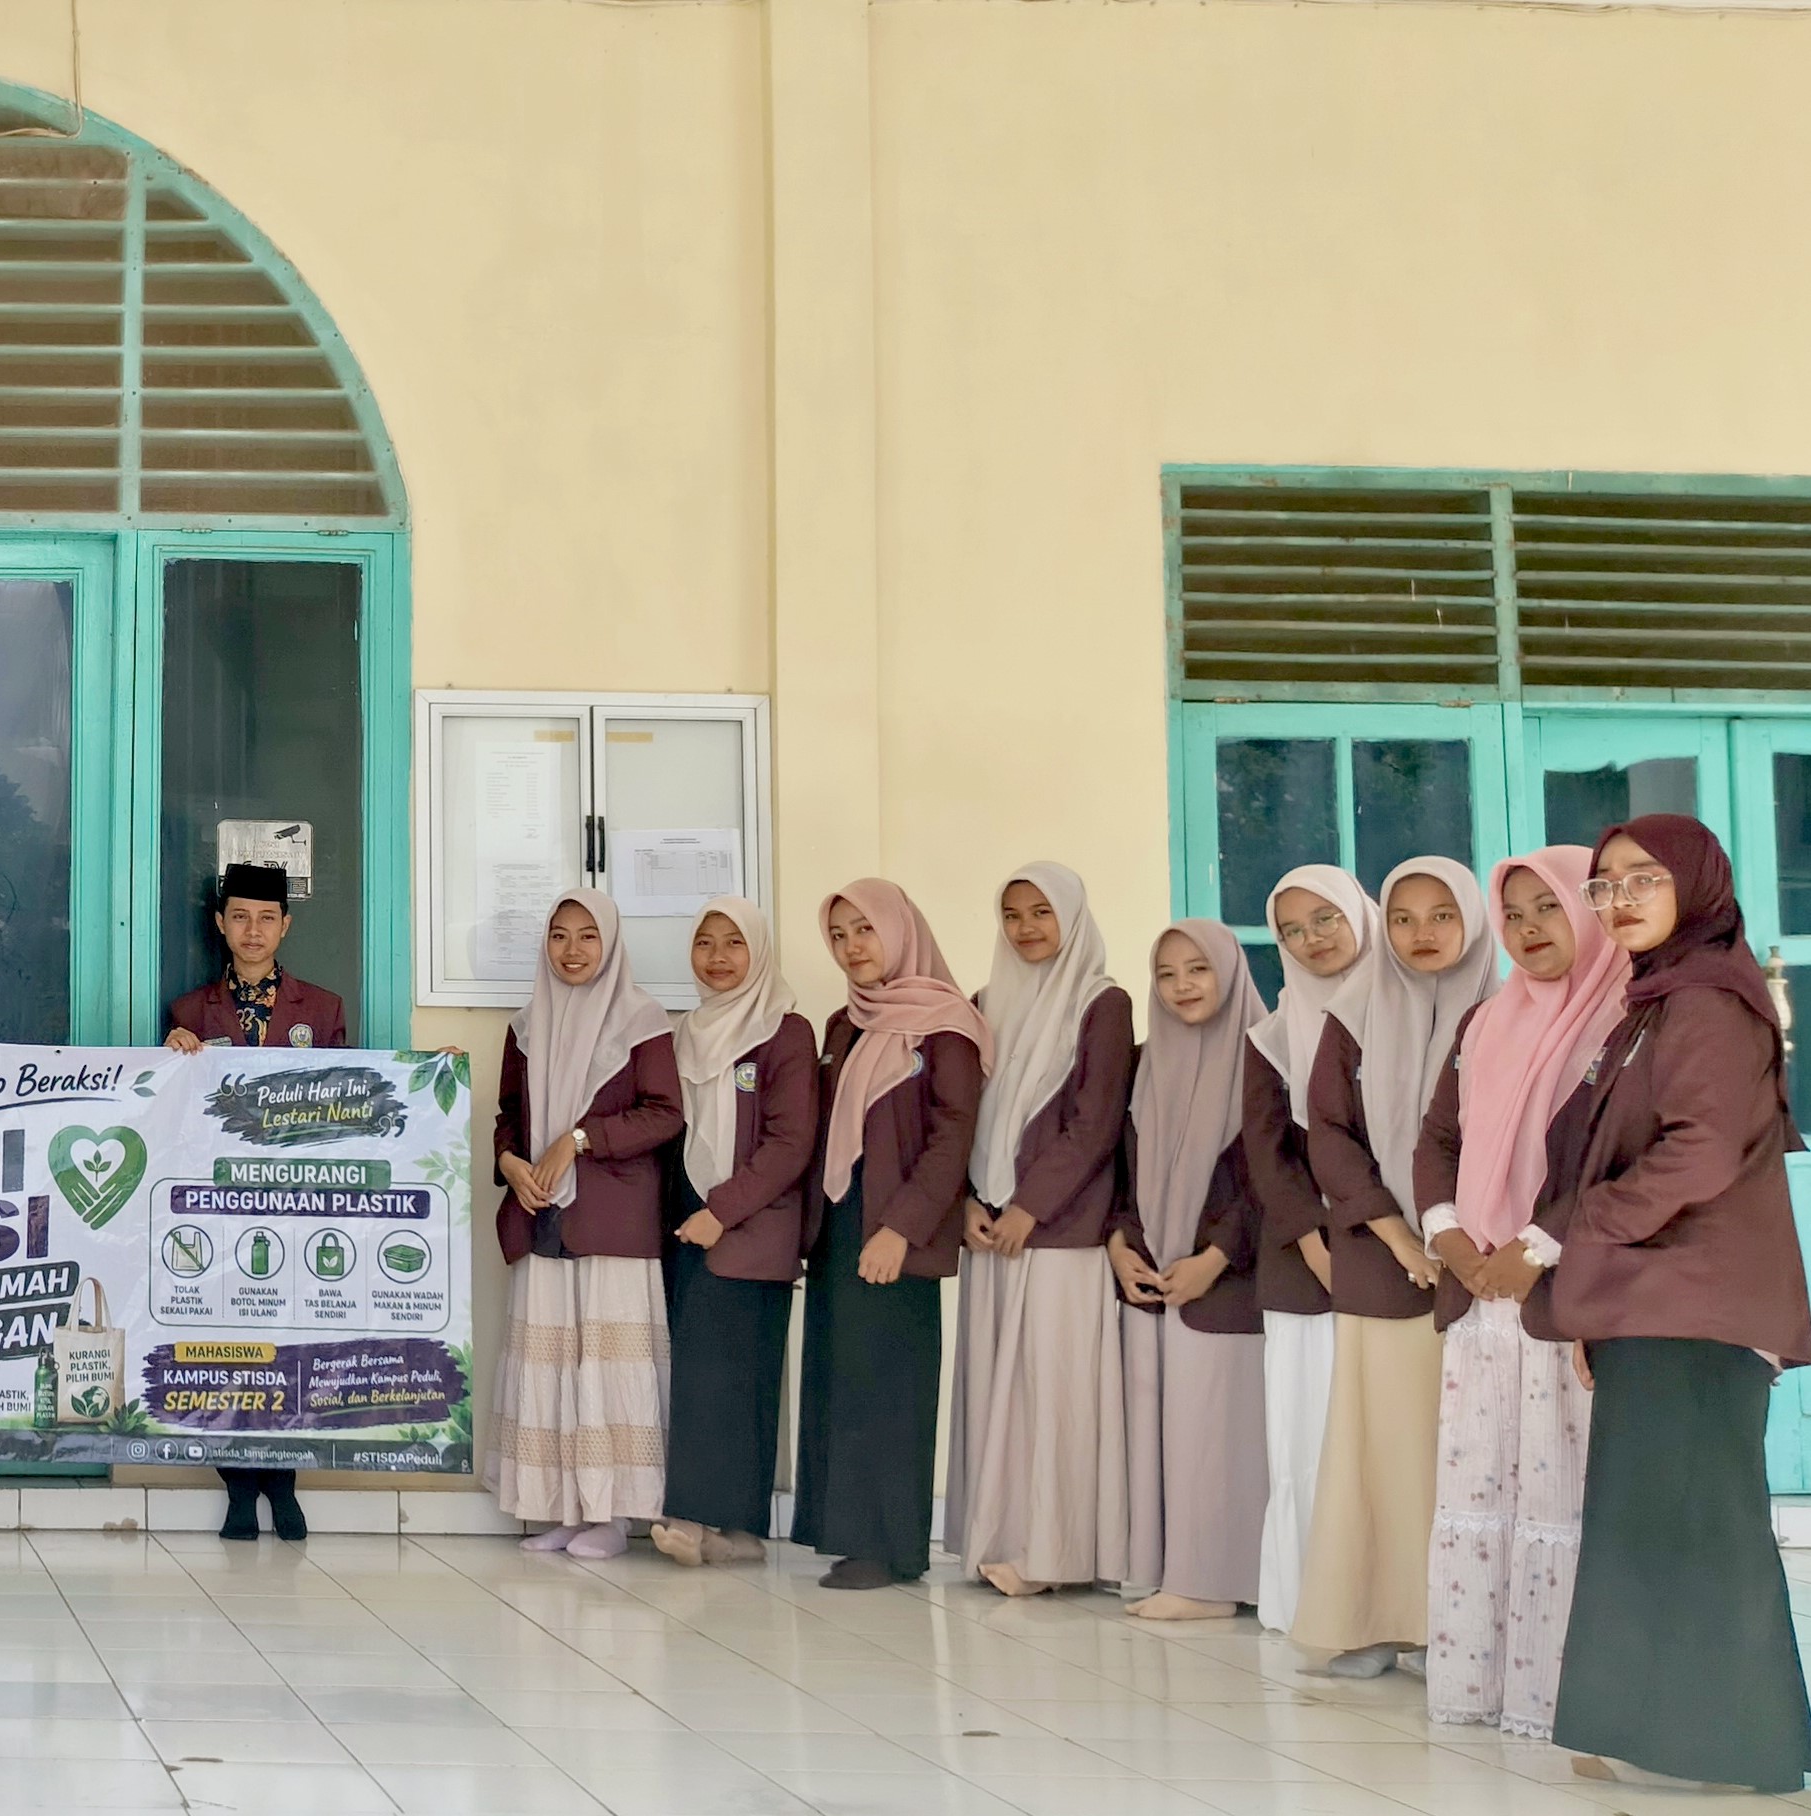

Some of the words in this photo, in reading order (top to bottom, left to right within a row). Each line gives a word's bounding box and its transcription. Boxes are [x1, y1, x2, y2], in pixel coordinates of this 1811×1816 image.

[16, 1063, 123, 1097] Beraksi!
[257, 1083, 303, 1106] Peduli
[308, 1081, 342, 1101] Hari
[346, 1079, 370, 1097] Ini,
[262, 1106, 322, 1128] Lestari
[327, 1101, 374, 1122] Nanti
[231, 1164, 366, 1184] MENGURANGI
[186, 1191, 325, 1211] PENGGUNAAN
[332, 1194, 416, 1213] PLASTIK
[239, 1287, 278, 1295] GUNAKAN
[319, 1289, 342, 1297] BAWA
[372, 1291, 411, 1299] GUNAKAN
[231, 1298, 255, 1306] BOTOL
[259, 1298, 285, 1306] MINUM
[321, 1300, 356, 1308] BELANJA
[374, 1302, 403, 1310] MAKAN
[413, 1302, 441, 1310] MINUM
[251, 1309, 277, 1317] ULANG
[69, 1350, 110, 1360] KURANGI
[186, 1346, 263, 1358] MAHASISWA
[71, 1361, 110, 1371] PLASTIK,
[313, 1355, 357, 1372] Bergerak
[360, 1354, 404, 1367] Bersama
[66, 1373, 89, 1383] PILIH
[91, 1372, 114, 1381] BUMI
[164, 1370, 228, 1384] KAMPUS
[233, 1370, 287, 1385] STISDA
[309, 1374, 368, 1390] Mewujudkan
[370, 1372, 408, 1386] Kampus
[164, 1391, 266, 1411] SEMESTER
[271, 1391, 284, 1411] 2
[310, 1391, 343, 1407] Sosial,
[348, 1391, 367, 1404] dan
[370, 1388, 445, 1404] Berkelanjutan
[7, 1402, 31, 1412] BUMI
[354, 1452, 442, 1465] #STISDAPeduli
